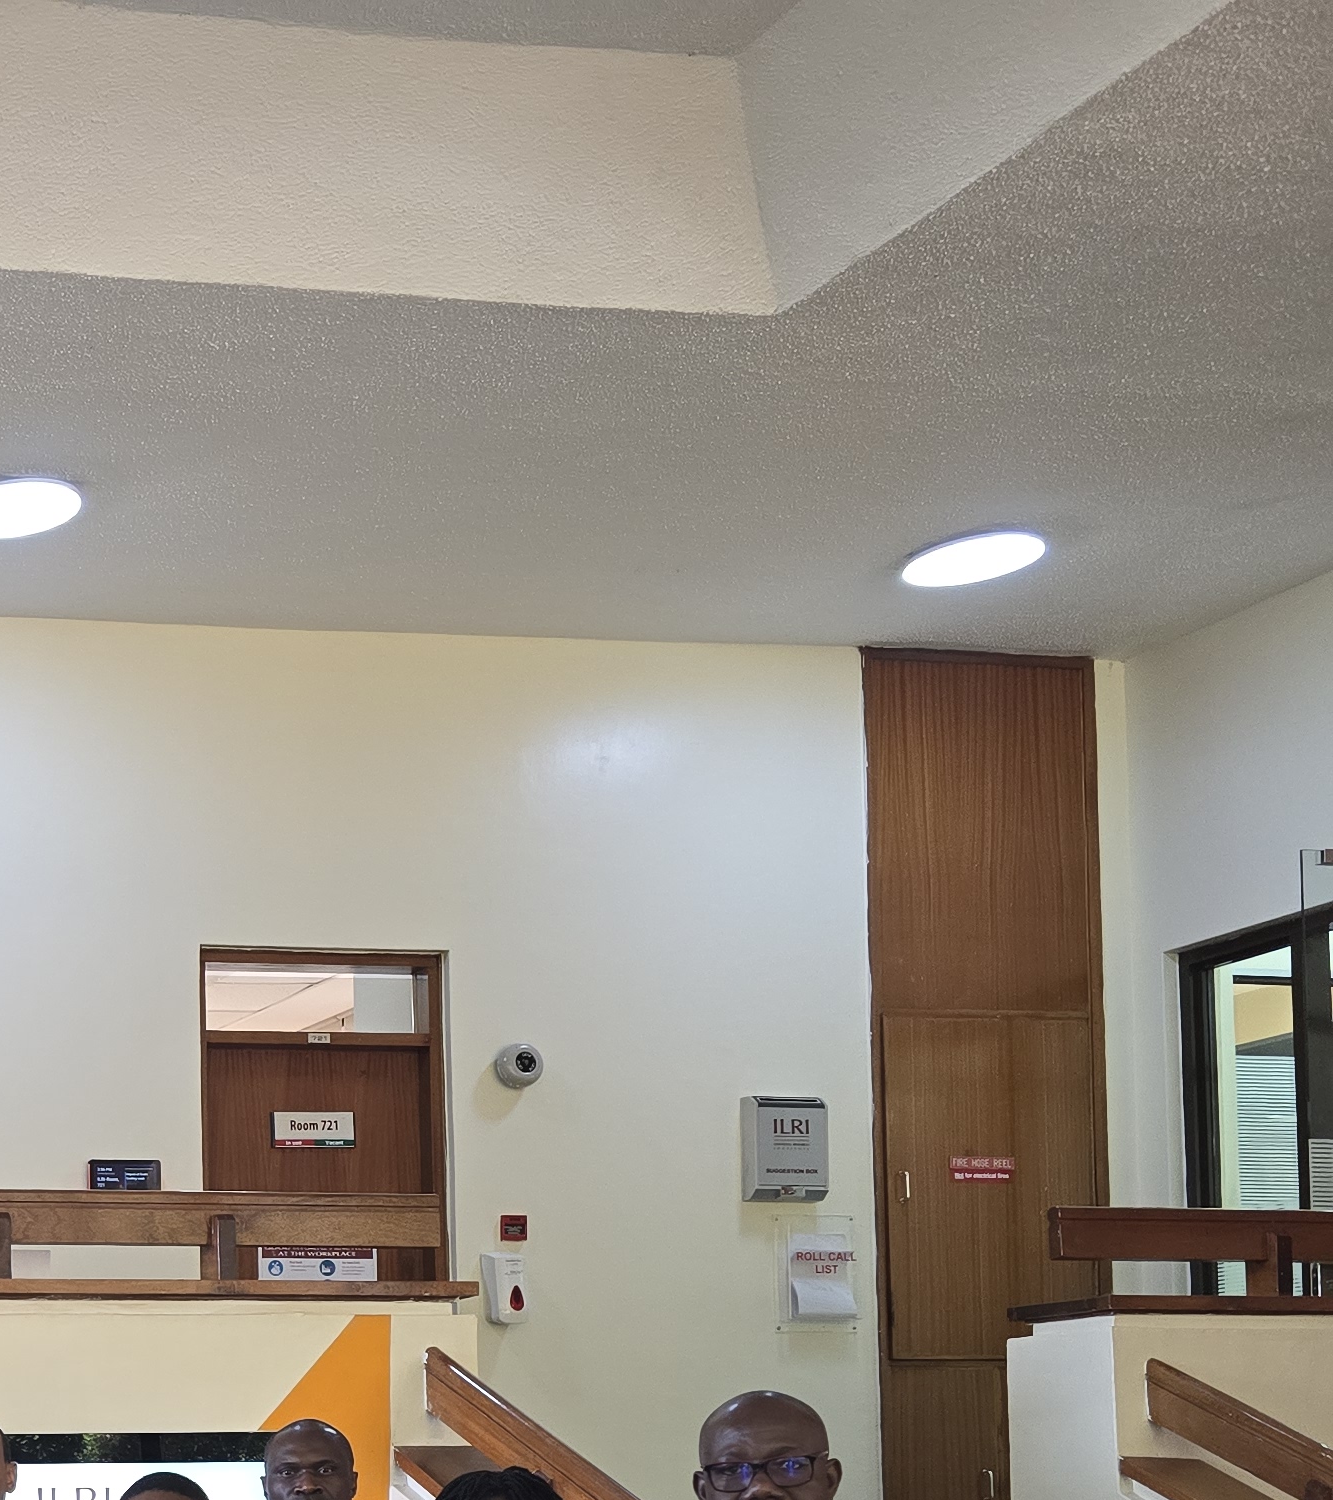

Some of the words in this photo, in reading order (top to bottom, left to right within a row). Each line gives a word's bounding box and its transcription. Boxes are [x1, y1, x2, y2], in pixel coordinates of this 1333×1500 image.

[290, 1120, 318, 1131] Room
[321, 1120, 339, 1131] 721
[773, 1118, 810, 1135] ILRI
[953, 1158, 968, 1167] FIRE
[972, 1159, 989, 1168] HOSE
[993, 1160, 1011, 1168] REEL
[796, 1251, 826, 1261] ROLL
[828, 1251, 857, 1262] CALL
[815, 1265, 838, 1274] LIST
